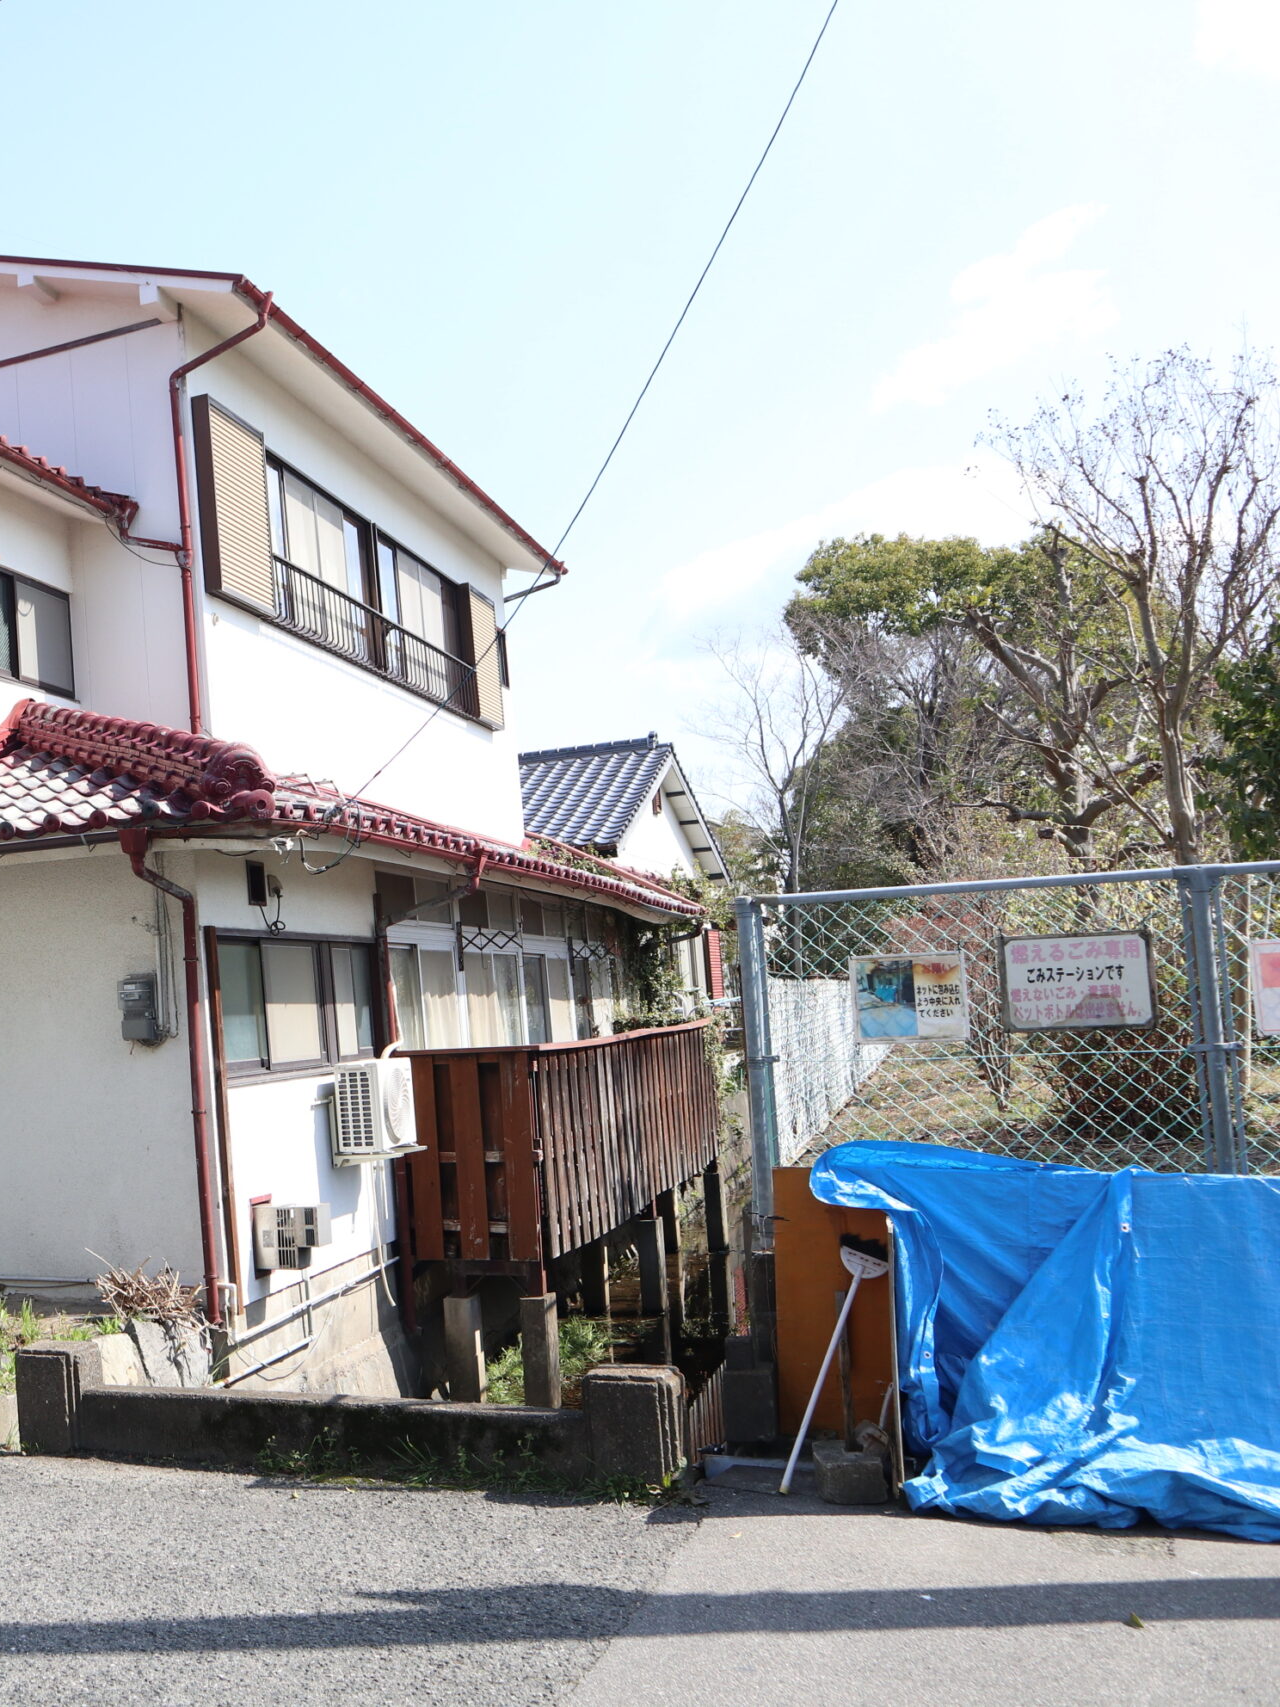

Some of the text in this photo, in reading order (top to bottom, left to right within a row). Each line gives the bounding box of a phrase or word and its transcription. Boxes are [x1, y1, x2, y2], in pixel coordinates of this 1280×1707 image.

[1011, 939, 1141, 964] 燃えるごみ専用
[1026, 964, 1125, 983] ごみステーションです
[917, 996, 961, 1007] よう中央に入れ
[919, 1009, 953, 1018] てください
